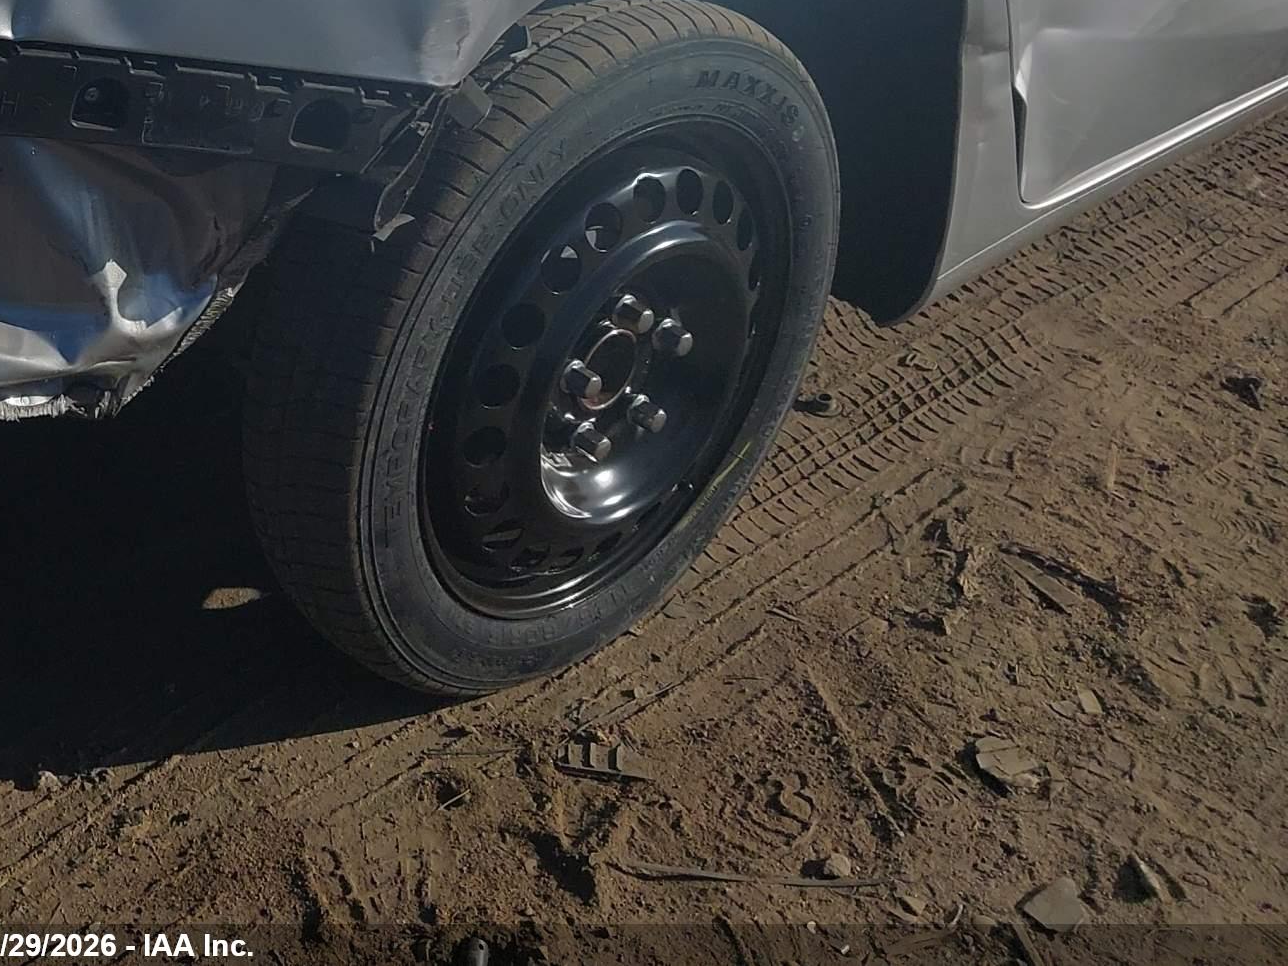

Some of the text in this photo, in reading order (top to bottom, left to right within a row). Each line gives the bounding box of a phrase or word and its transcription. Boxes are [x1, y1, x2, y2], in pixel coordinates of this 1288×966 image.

[695, 69, 799, 126] MAXXIS
[384, 314, 453, 549] TEMPORARY
[499, 138, 566, 220] ONLY
